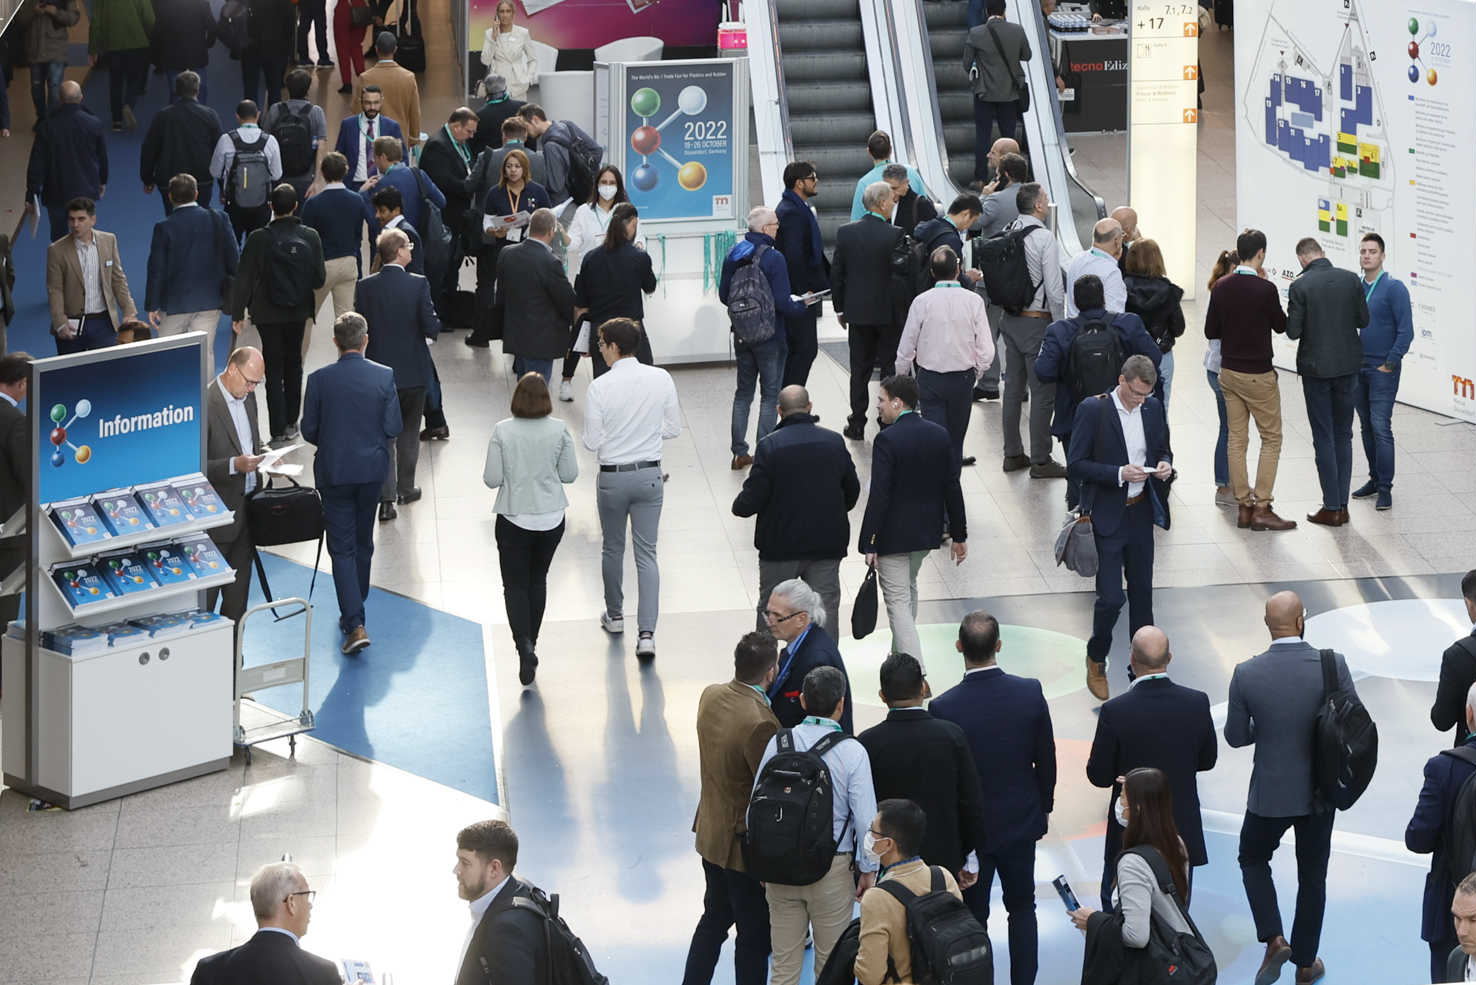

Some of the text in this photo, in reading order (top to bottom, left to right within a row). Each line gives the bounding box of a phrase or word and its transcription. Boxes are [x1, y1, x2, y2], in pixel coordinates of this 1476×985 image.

[1148, 17, 1164, 30] 17
[1430, 41, 1451, 58] 2022
[1070, 60, 1128, 72] tecnoEdiz
[684, 120, 727, 140] 2022
[702, 140, 727, 148] OCTOBER
[99, 404, 194, 438] Information
